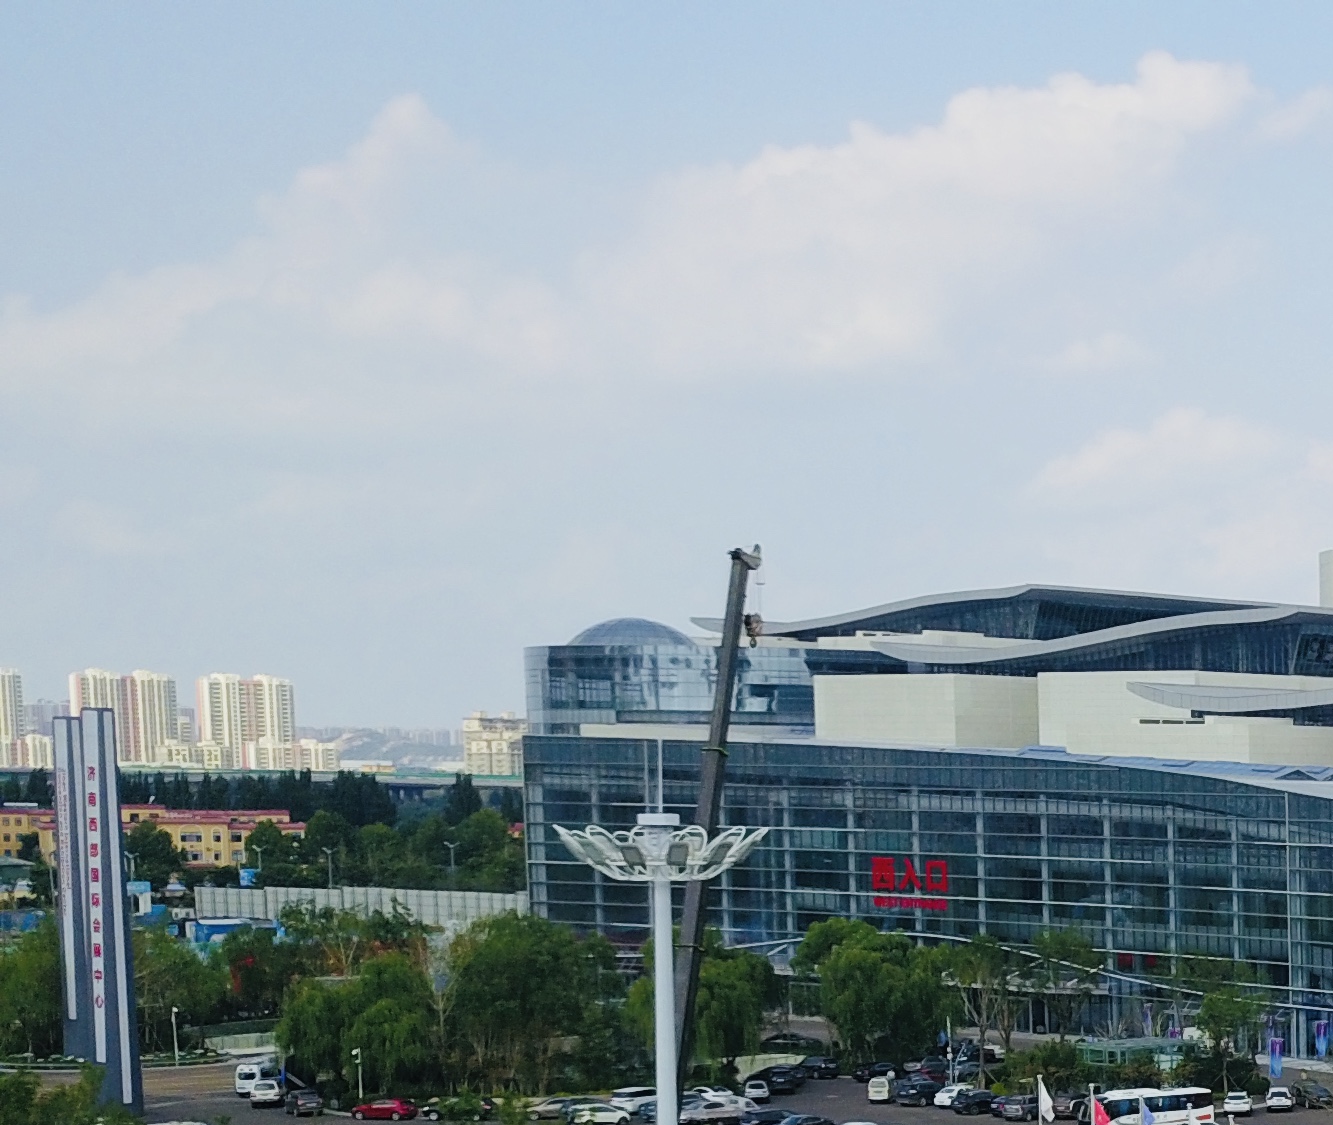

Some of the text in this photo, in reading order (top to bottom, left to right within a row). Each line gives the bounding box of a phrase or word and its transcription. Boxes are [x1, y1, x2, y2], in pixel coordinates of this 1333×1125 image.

[87, 766, 103, 1008] 济南西部国际会展中心
[871, 856, 948, 892] 西入口
